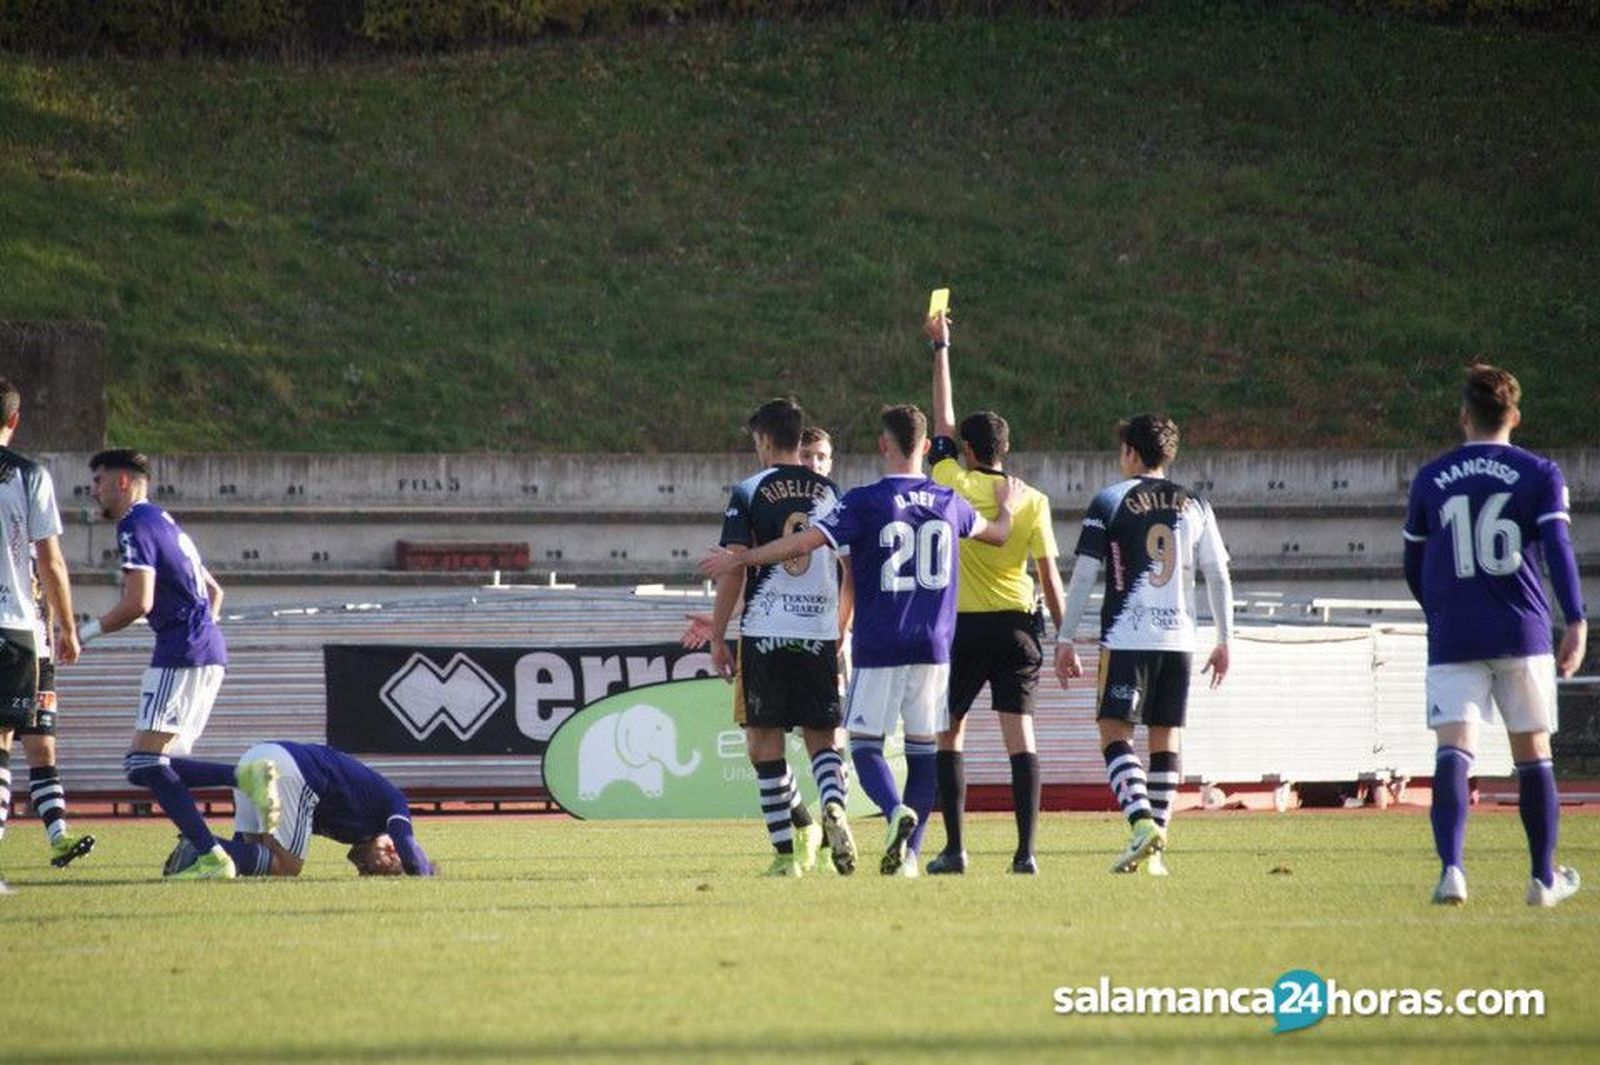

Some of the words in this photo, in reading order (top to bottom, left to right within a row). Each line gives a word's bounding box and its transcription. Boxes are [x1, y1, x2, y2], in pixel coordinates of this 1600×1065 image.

[1433, 457, 1521, 490] MANCUSO
[879, 518, 953, 592] 20
[1145, 522, 1179, 588] 9
[1439, 491, 1522, 579] 16
[142, 692, 155, 720] 7
